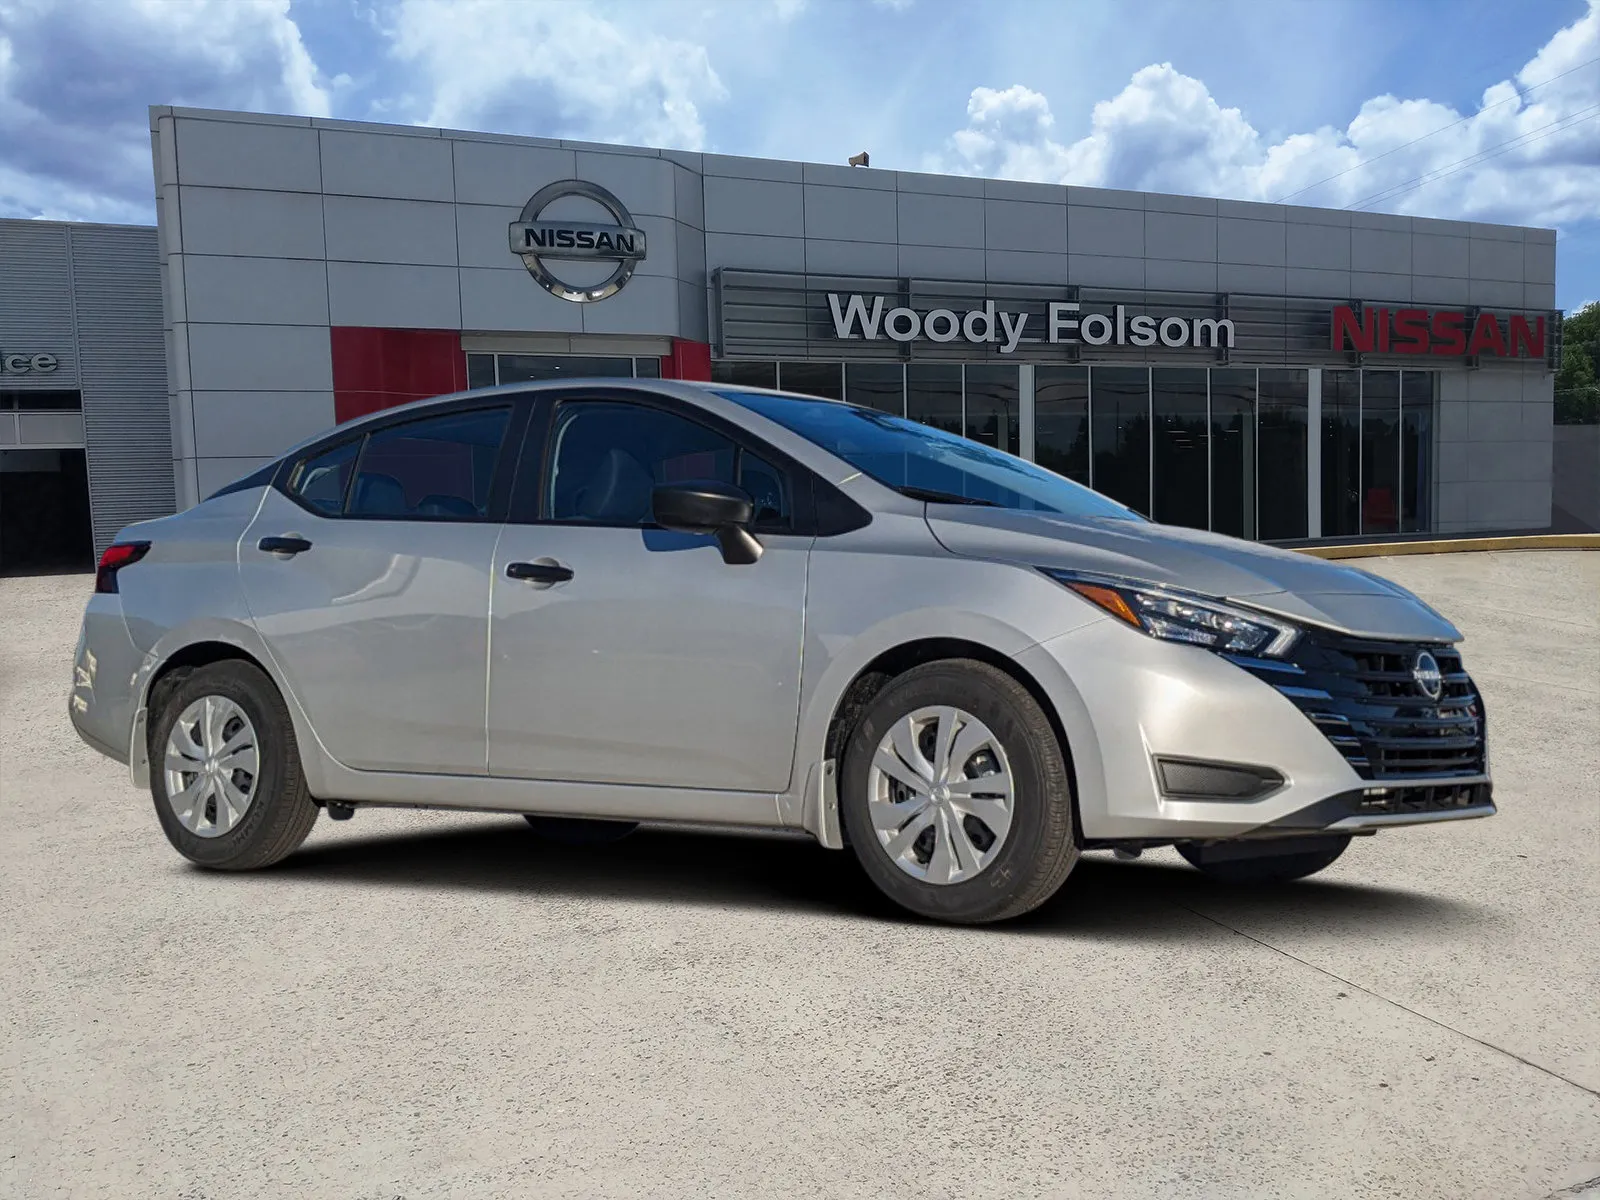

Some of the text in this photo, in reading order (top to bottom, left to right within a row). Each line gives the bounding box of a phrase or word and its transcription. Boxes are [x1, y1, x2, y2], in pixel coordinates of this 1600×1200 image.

[525, 228, 634, 252] NISSAN
[827, 293, 1235, 353] Woody Folsom
[1333, 305, 1544, 358] NISSAN
[0, 353, 57, 373] ce
